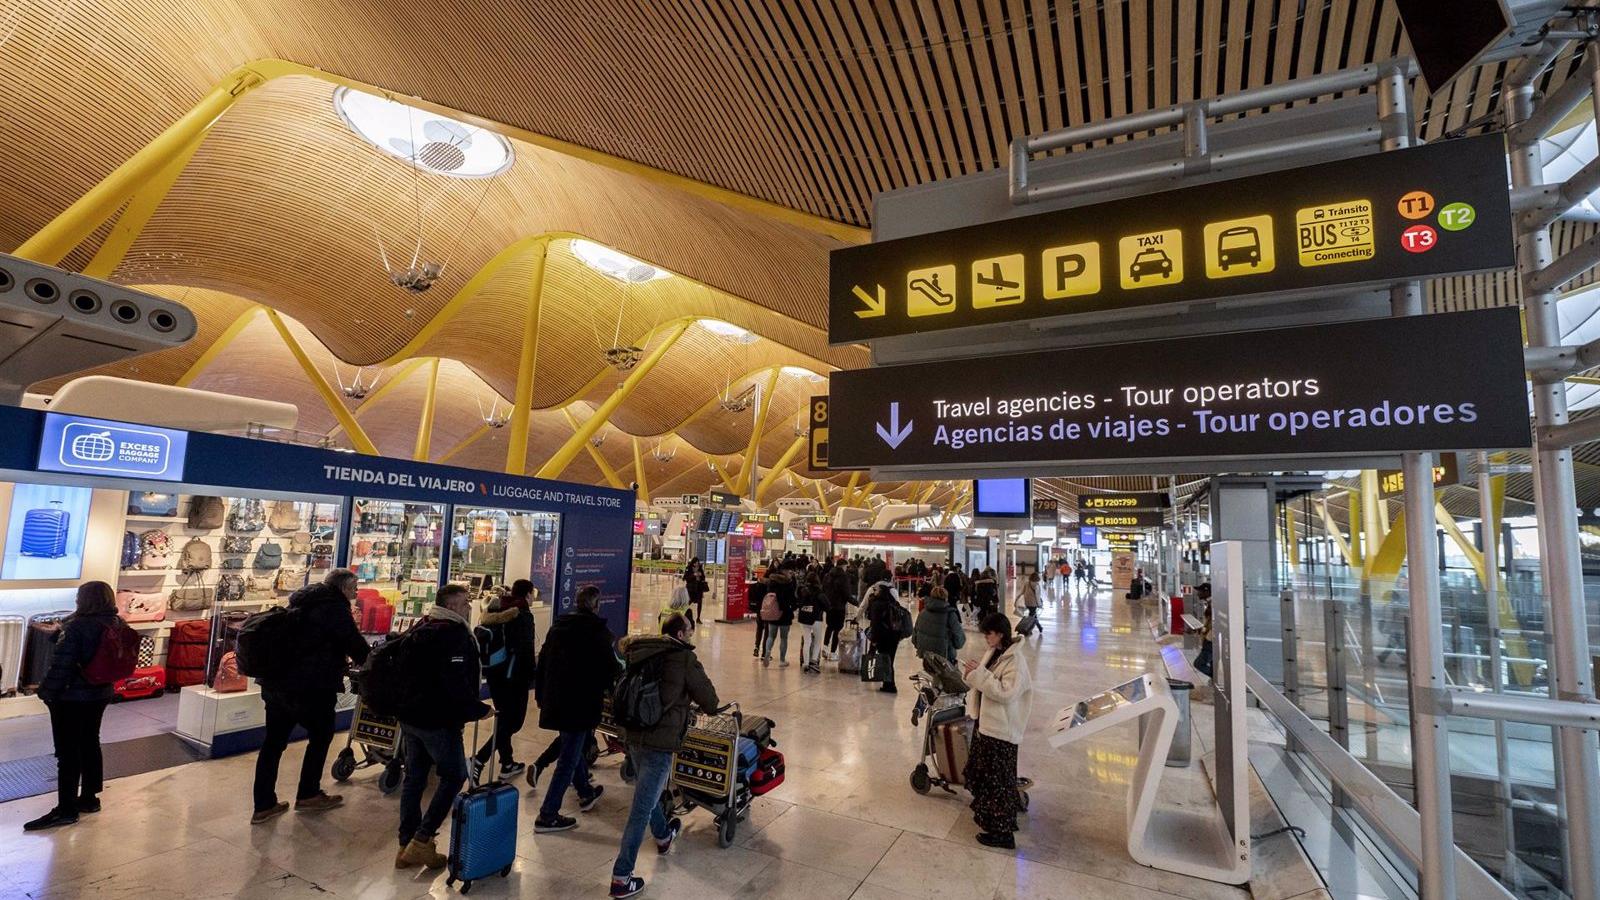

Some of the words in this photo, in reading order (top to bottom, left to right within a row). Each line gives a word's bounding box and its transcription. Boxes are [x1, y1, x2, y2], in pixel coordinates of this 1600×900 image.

[1328, 205, 1369, 216] Tránsito
[1402, 197, 1429, 213] T1
[1442, 207, 1472, 225] T2
[1137, 235, 1163, 247] TAXI
[1300, 224, 1337, 249] BUS
[1404, 230, 1433, 248] T3
[1315, 248, 1372, 261] Connecting
[1056, 254, 1086, 291] P
[933, 397, 990, 418] Travel
[997, 391, 1096, 418] agencies
[1121, 386, 1174, 407] Tour
[1183, 378, 1320, 407] operators
[933, 421, 1044, 449] Agencias
[1049, 418, 1081, 440] de
[1087, 414, 1170, 442] viajes
[1193, 410, 1261, 434] Tour
[1268, 400, 1479, 436] operadores
[119, 448, 160, 459] BAGGAGE
[120, 441, 161, 452] EXCESS
[118, 455, 159, 464] COMPANY
[323, 465, 385, 484] TIENDA
[387, 472, 416, 487] DEL
[418, 476, 475, 493] VIAJERO
[492, 484, 542, 500] LUGGAGE
[543, 490, 564, 502] AND
[564, 493, 596, 506] TRAVEL
[597, 496, 621, 508] STORE
